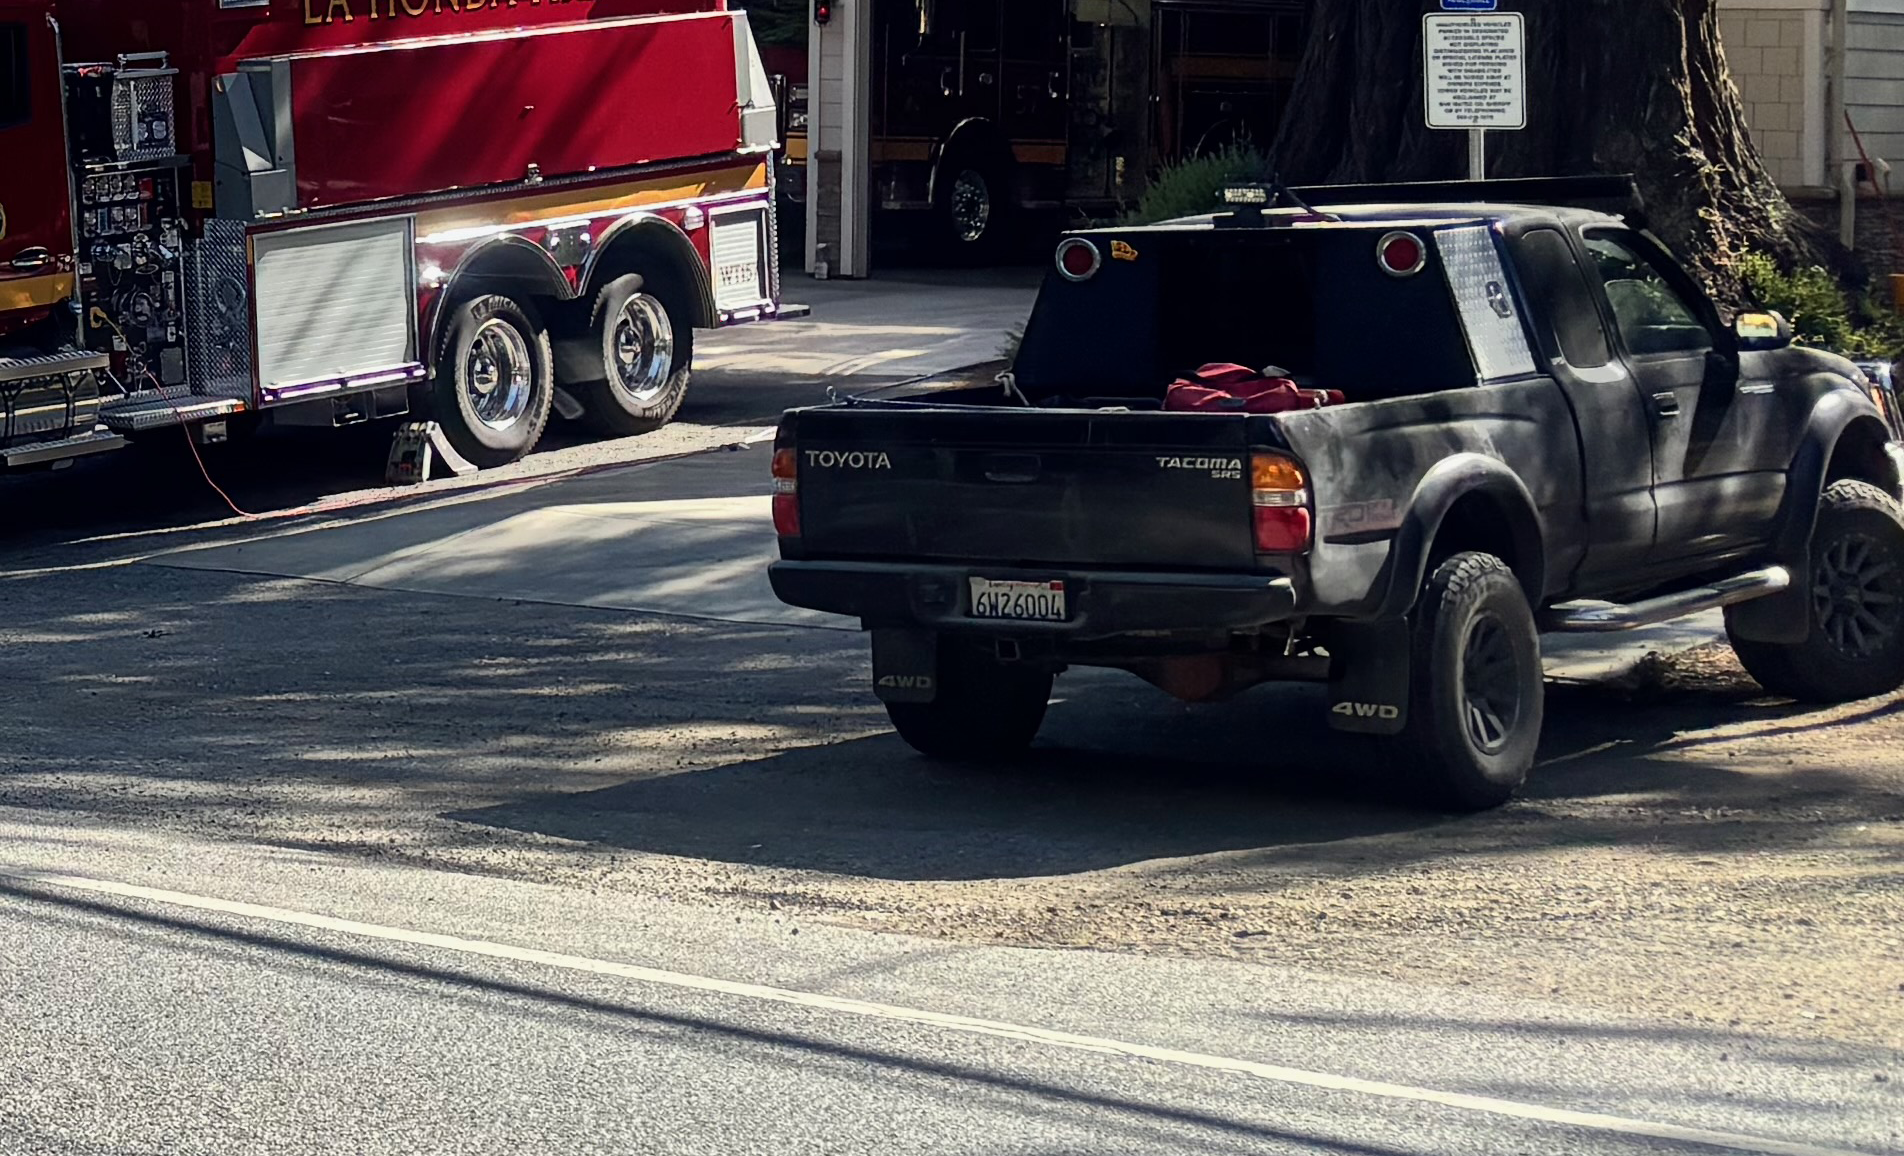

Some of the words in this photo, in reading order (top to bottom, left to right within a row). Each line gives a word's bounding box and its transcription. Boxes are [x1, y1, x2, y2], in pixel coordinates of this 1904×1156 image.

[805, 449, 892, 470] TOYOTA
[1155, 456, 1242, 470] TACOMA
[976, 591, 1062, 620] 6W26004
[878, 674, 931, 689] 4WD
[1332, 701, 1399, 721] 4WD
